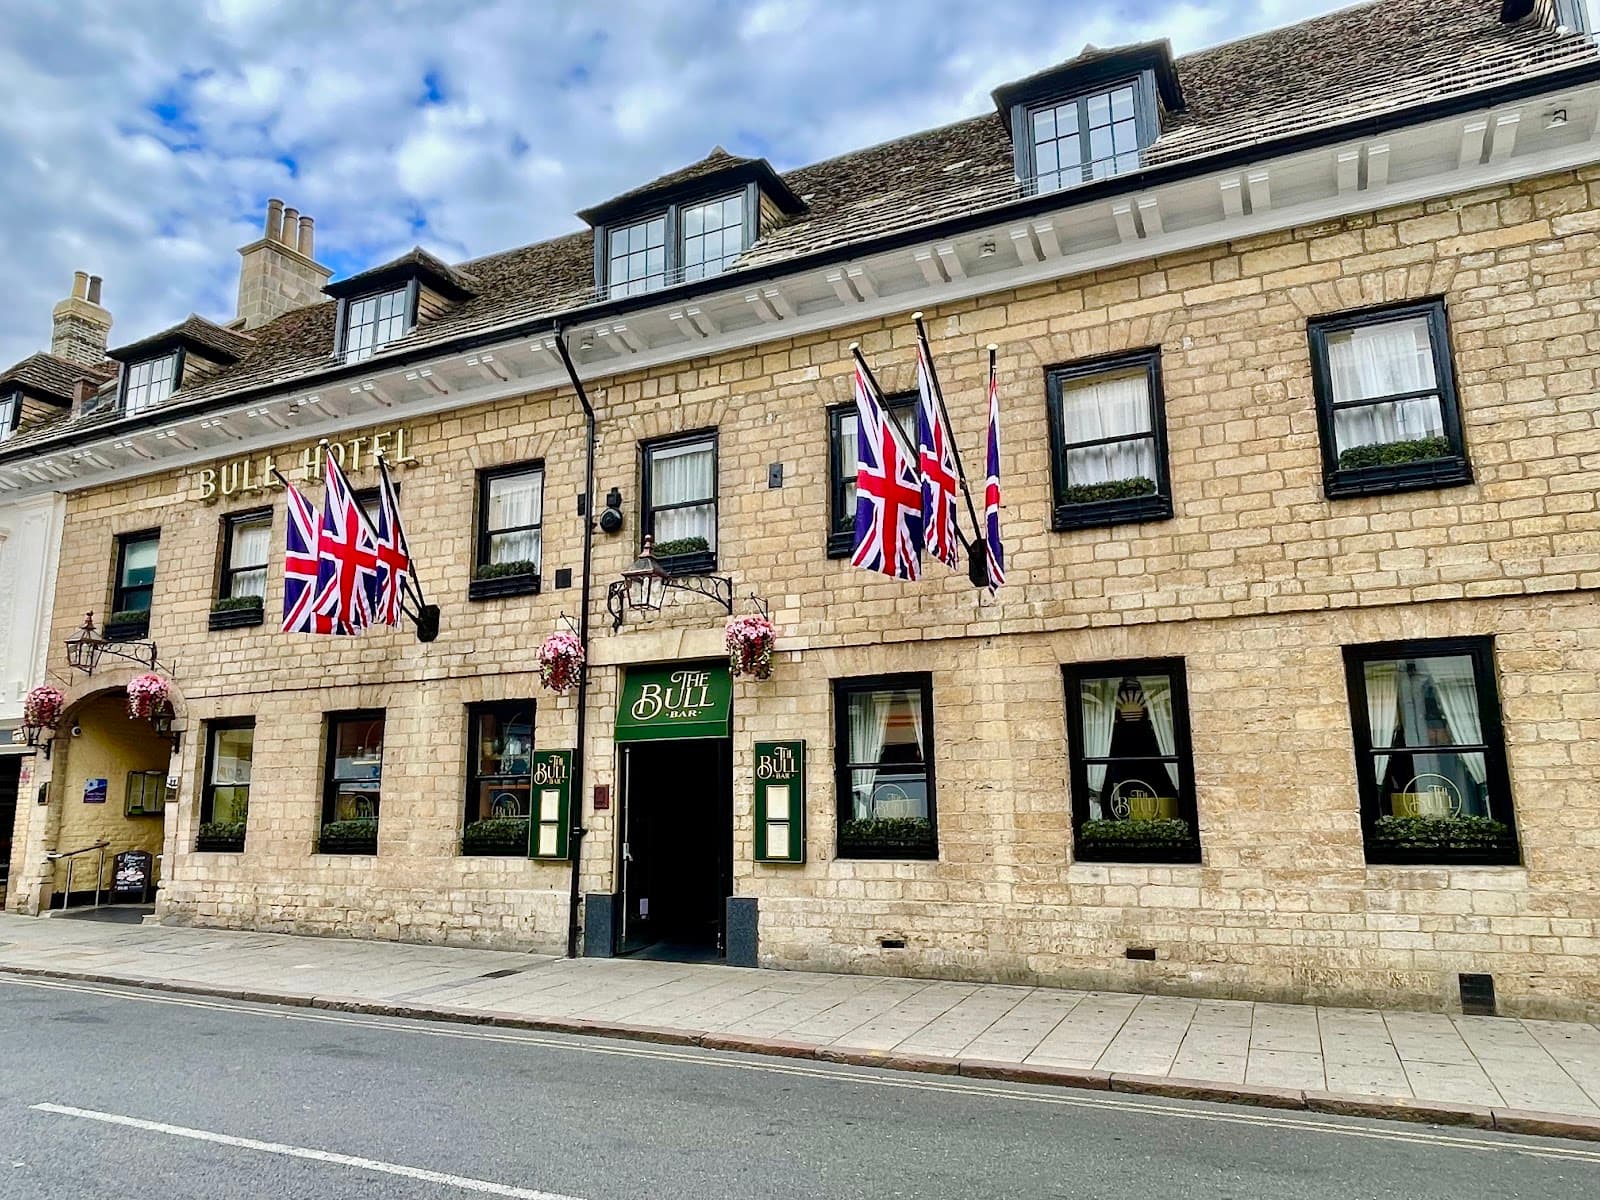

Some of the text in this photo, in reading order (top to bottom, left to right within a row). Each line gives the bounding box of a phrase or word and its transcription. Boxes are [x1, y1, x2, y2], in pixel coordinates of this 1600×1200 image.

[199, 428, 416, 498] BULL HOTEL
[671, 670, 711, 690] THE
[632, 684, 715, 720] BULL
[534, 762, 569, 785] BULL
[757, 755, 800, 779] BULL
